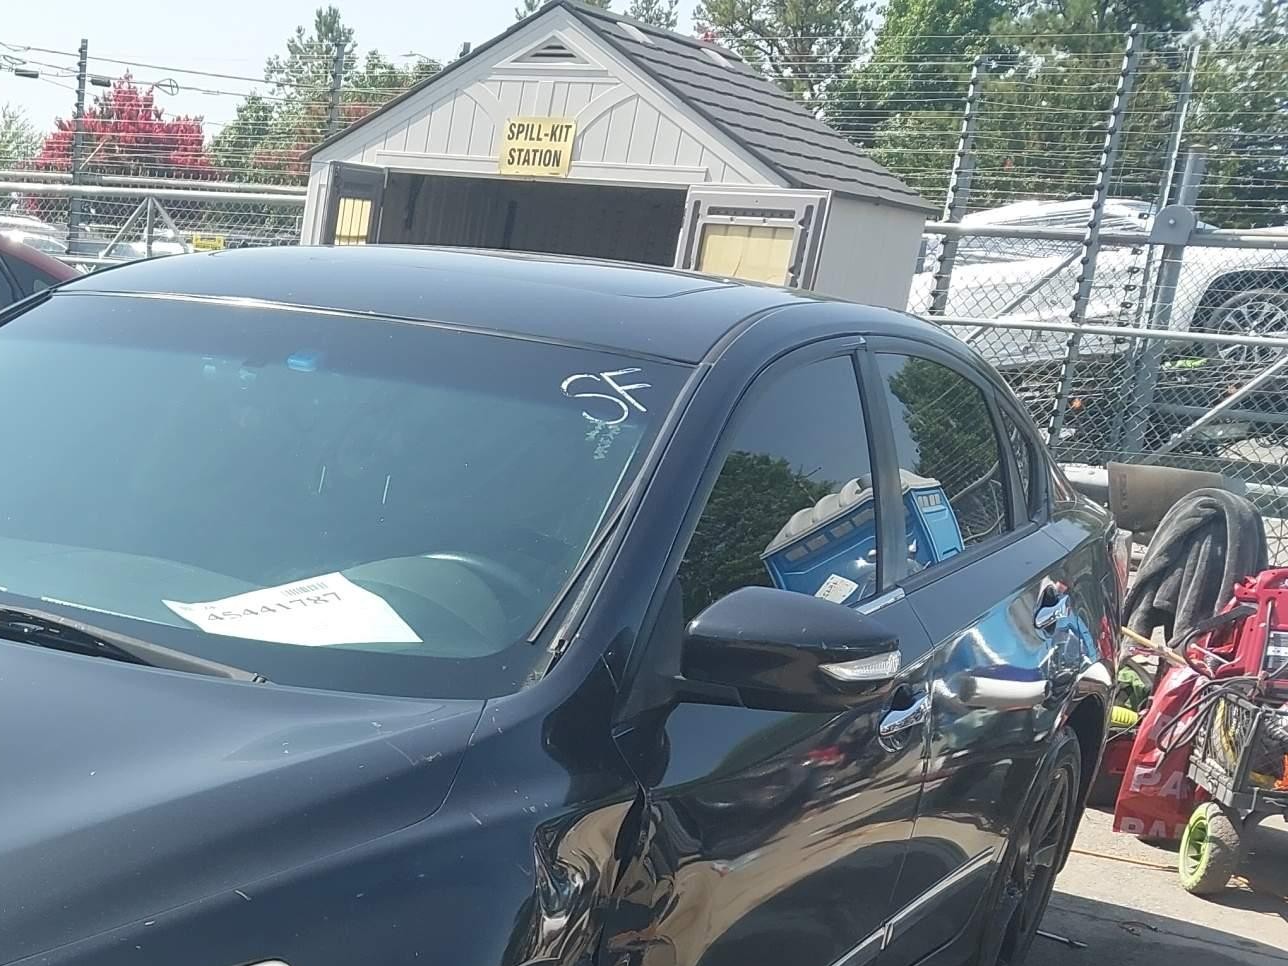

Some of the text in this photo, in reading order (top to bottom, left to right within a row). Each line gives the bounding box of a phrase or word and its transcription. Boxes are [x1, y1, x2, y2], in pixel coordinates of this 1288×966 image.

[507, 123, 572, 142] SPILL-KIT
[507, 148, 562, 167] STATION
[561, 368, 652, 425] SF
[207, 591, 342, 622] 45441787
